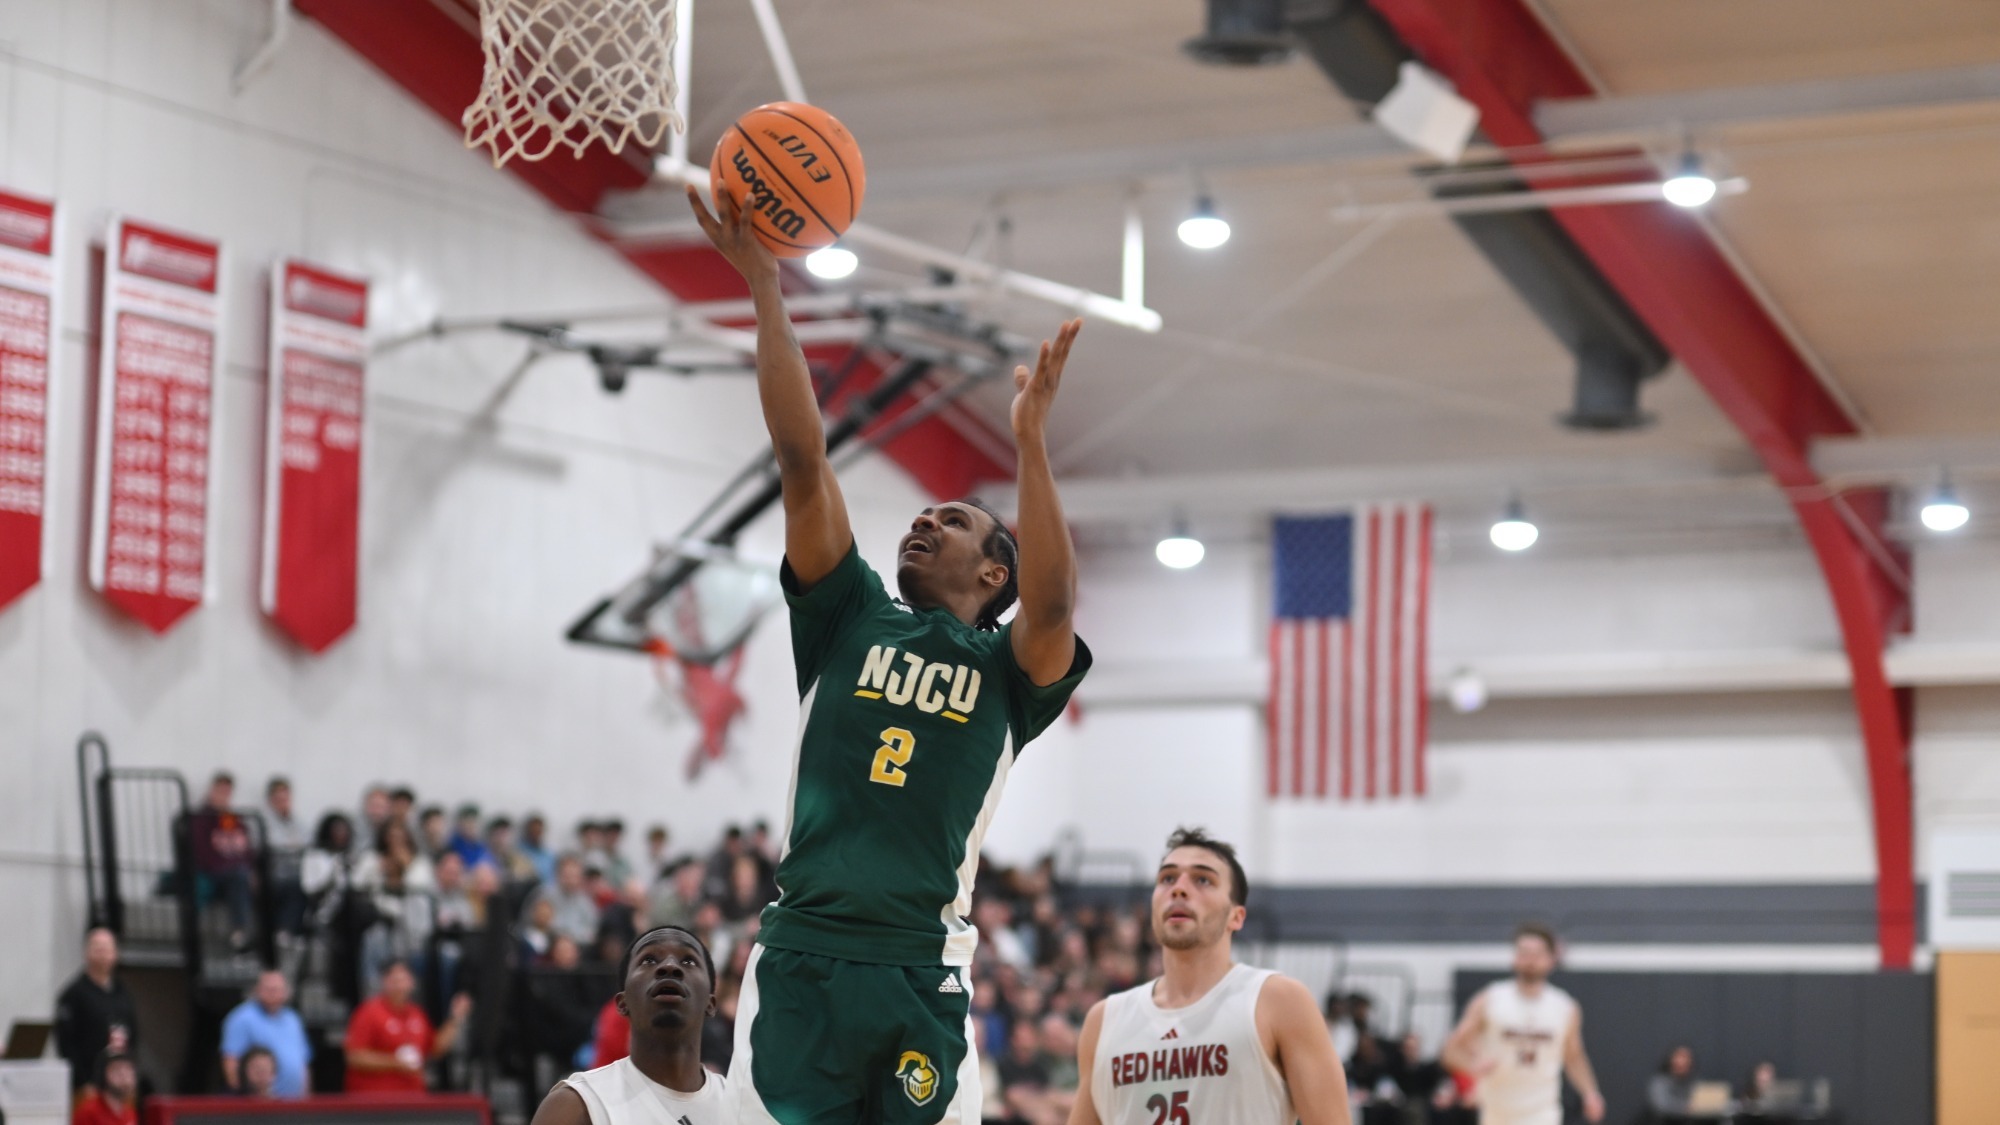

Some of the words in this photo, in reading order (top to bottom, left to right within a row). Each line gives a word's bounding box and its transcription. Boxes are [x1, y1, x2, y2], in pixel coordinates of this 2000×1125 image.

[732, 147, 806, 239] Wilson
[857, 645, 981, 714] NJCU
[869, 726, 916, 787] 2
[1112, 1052, 1149, 1088] RED
[1152, 1044, 1228, 1082] HAWKS
[1146, 1090, 1190, 1125] 25
